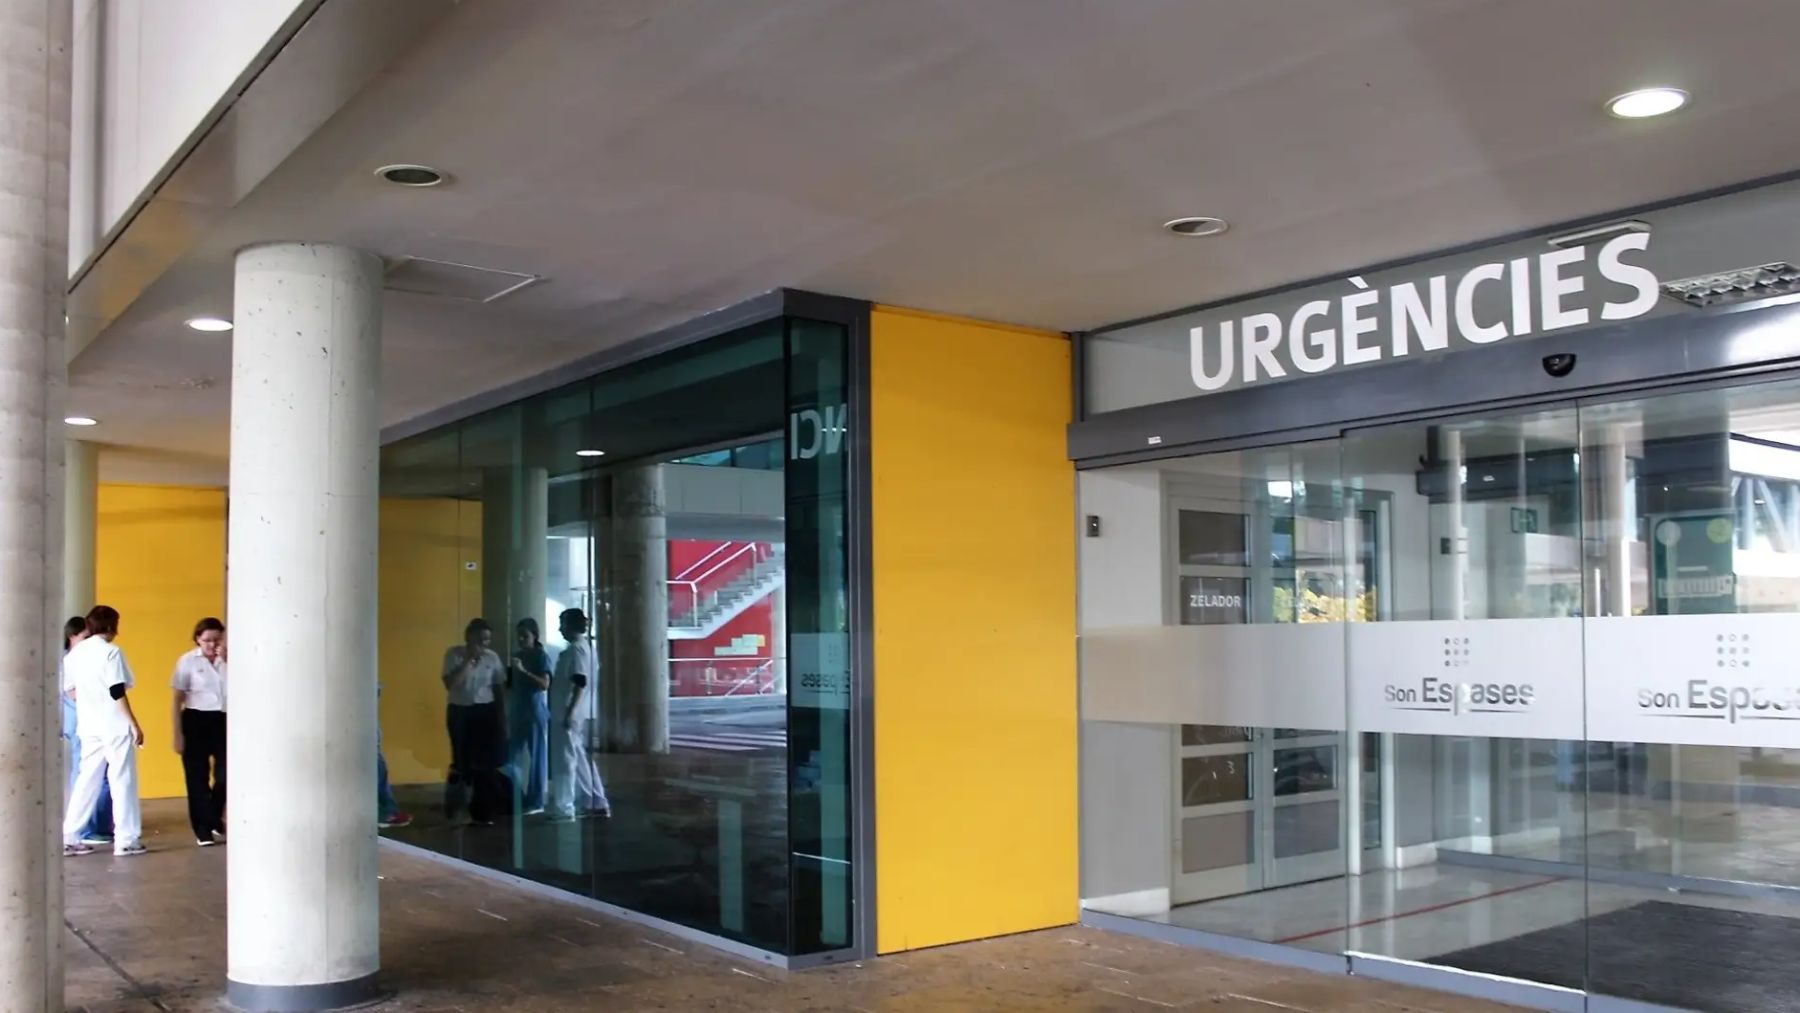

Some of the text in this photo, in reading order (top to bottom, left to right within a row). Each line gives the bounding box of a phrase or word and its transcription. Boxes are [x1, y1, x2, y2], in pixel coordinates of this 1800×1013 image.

[1189, 232, 1660, 391] URGÈNCIES
[1190, 594, 1242, 608] ZELADOR
[1385, 684, 1416, 702] Son
[1638, 688, 1680, 708] Son
